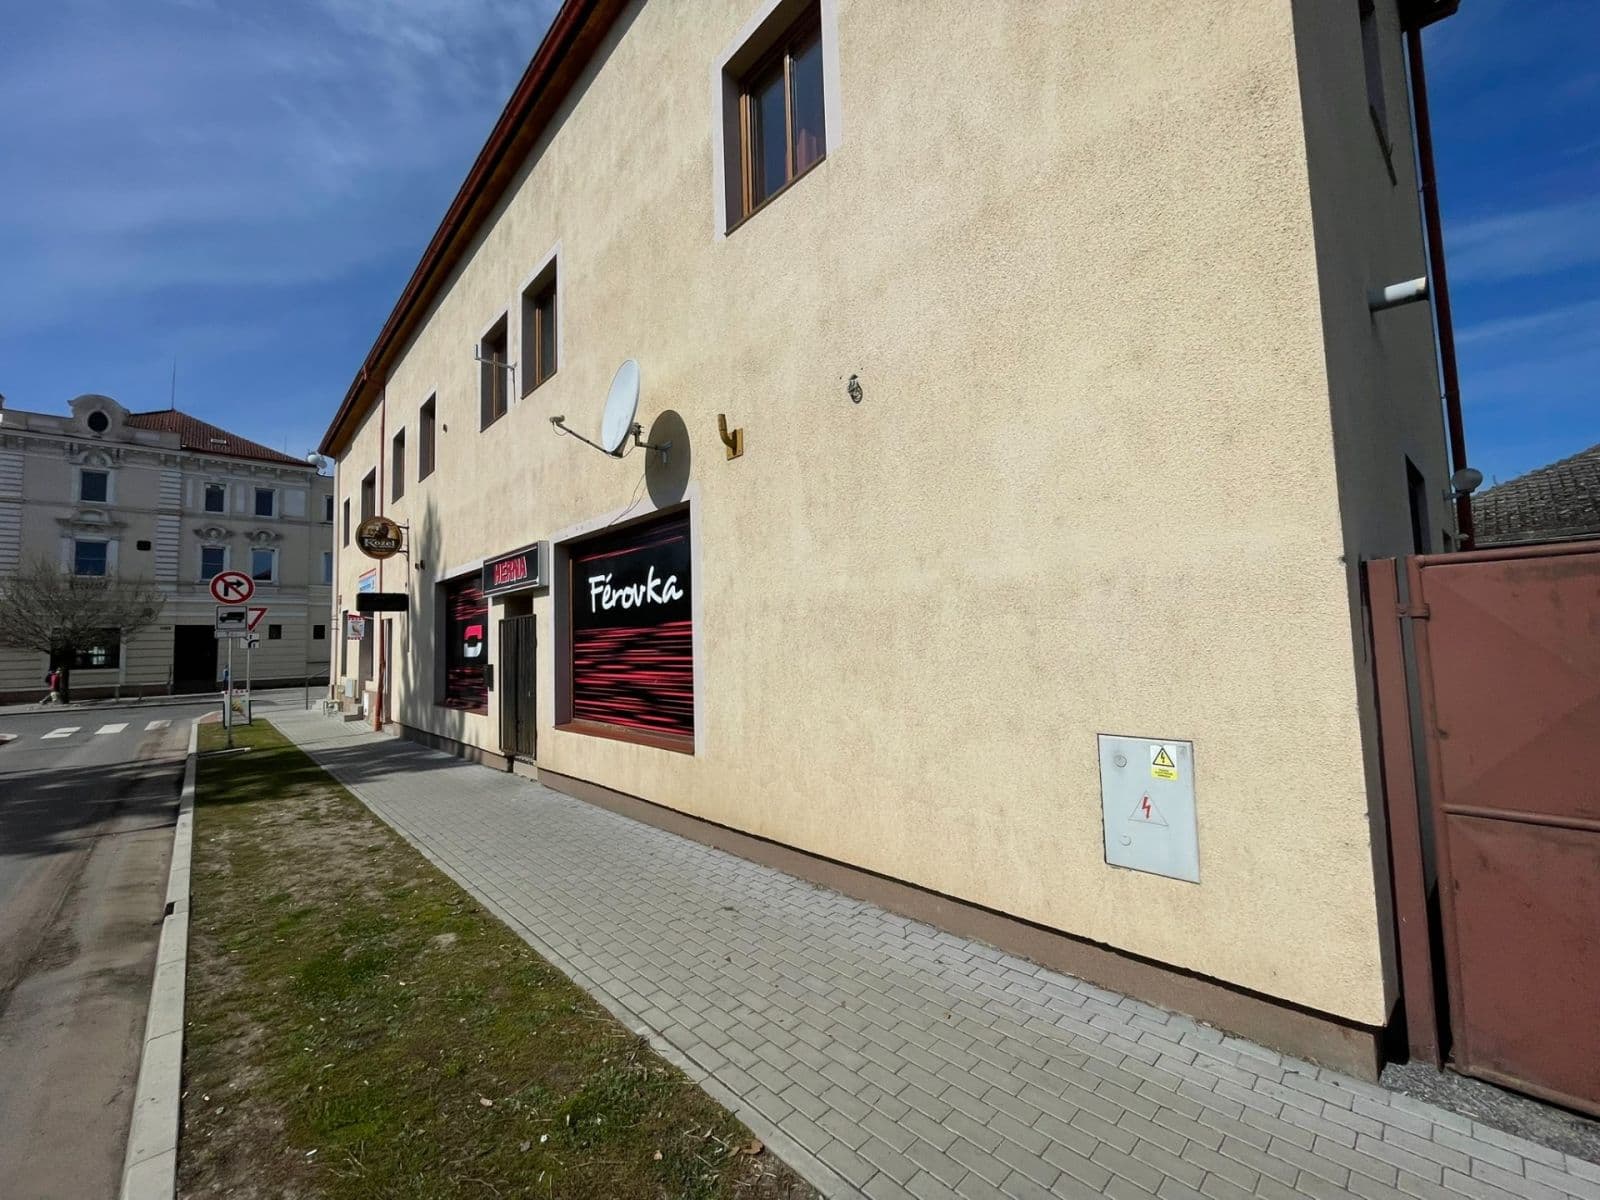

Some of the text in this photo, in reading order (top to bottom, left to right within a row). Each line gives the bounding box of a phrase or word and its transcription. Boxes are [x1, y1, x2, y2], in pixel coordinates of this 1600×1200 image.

[364, 538, 395, 548] Kozel
[494, 556, 527, 585] HERNA
[588, 566, 683, 613] Férovka
